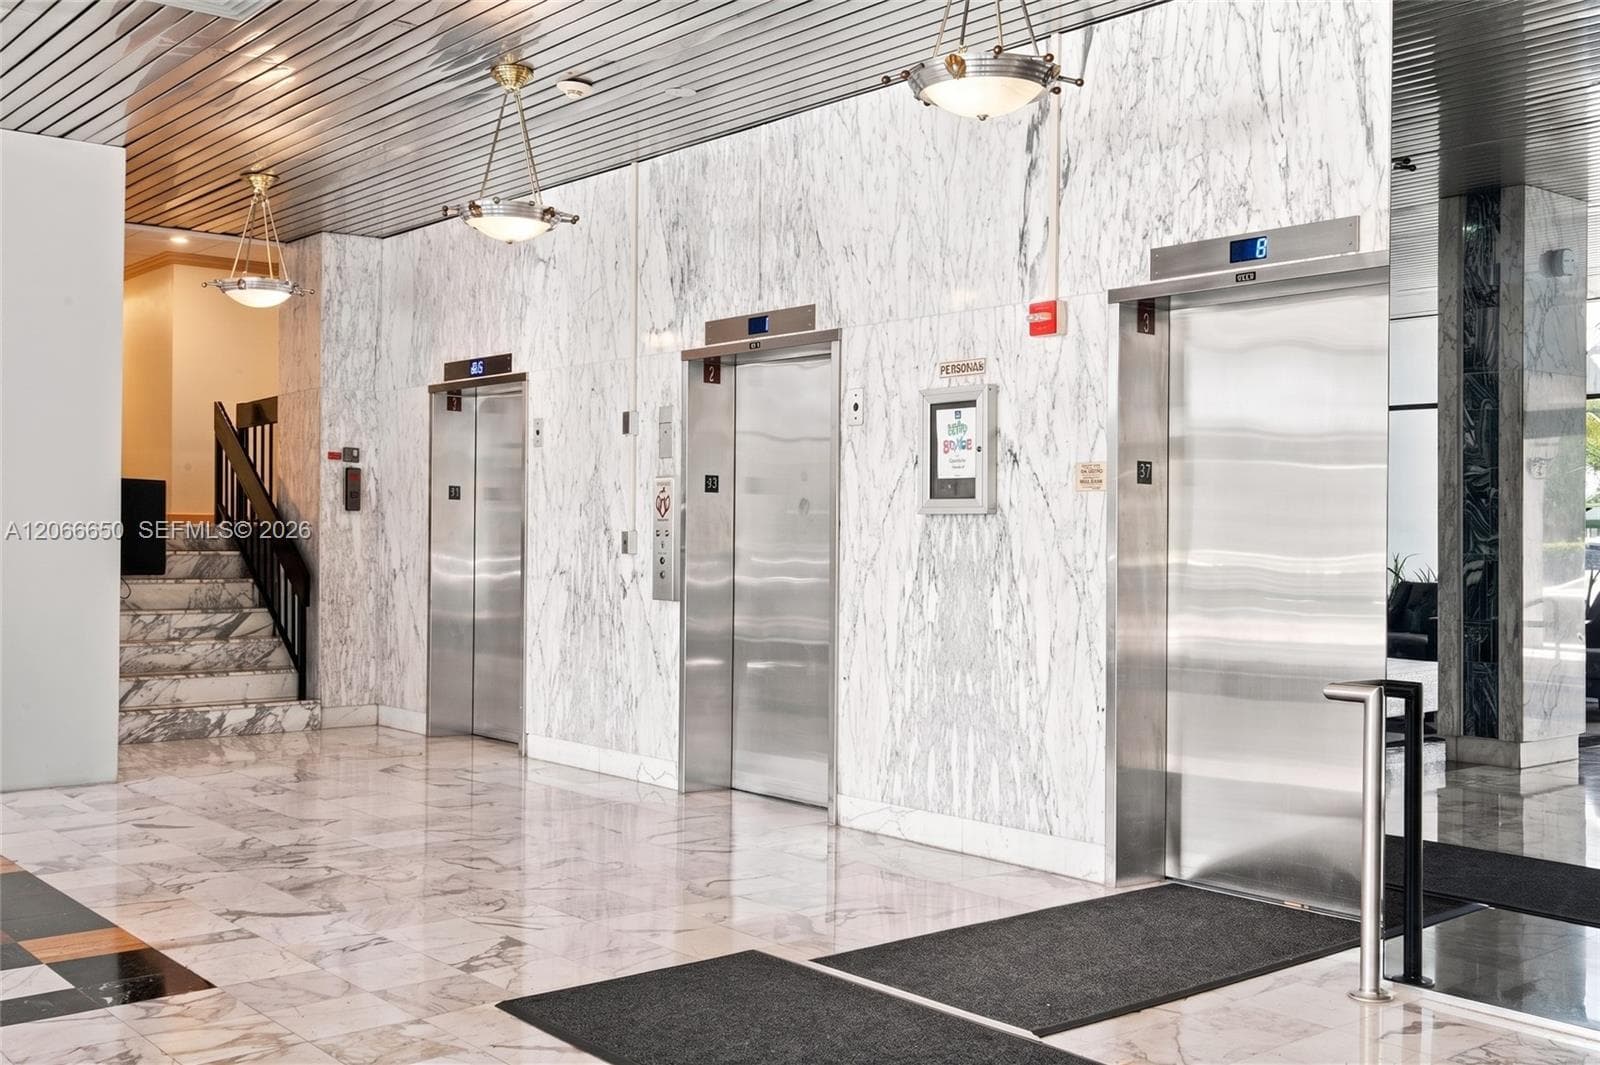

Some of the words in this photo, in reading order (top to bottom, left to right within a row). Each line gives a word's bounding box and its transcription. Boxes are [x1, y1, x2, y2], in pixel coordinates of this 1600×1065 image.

[1255, 236, 1268, 259] 8
[1143, 312, 1150, 333] 3
[708, 366, 715, 382] 2
[1139, 463, 1151, 479] 37
